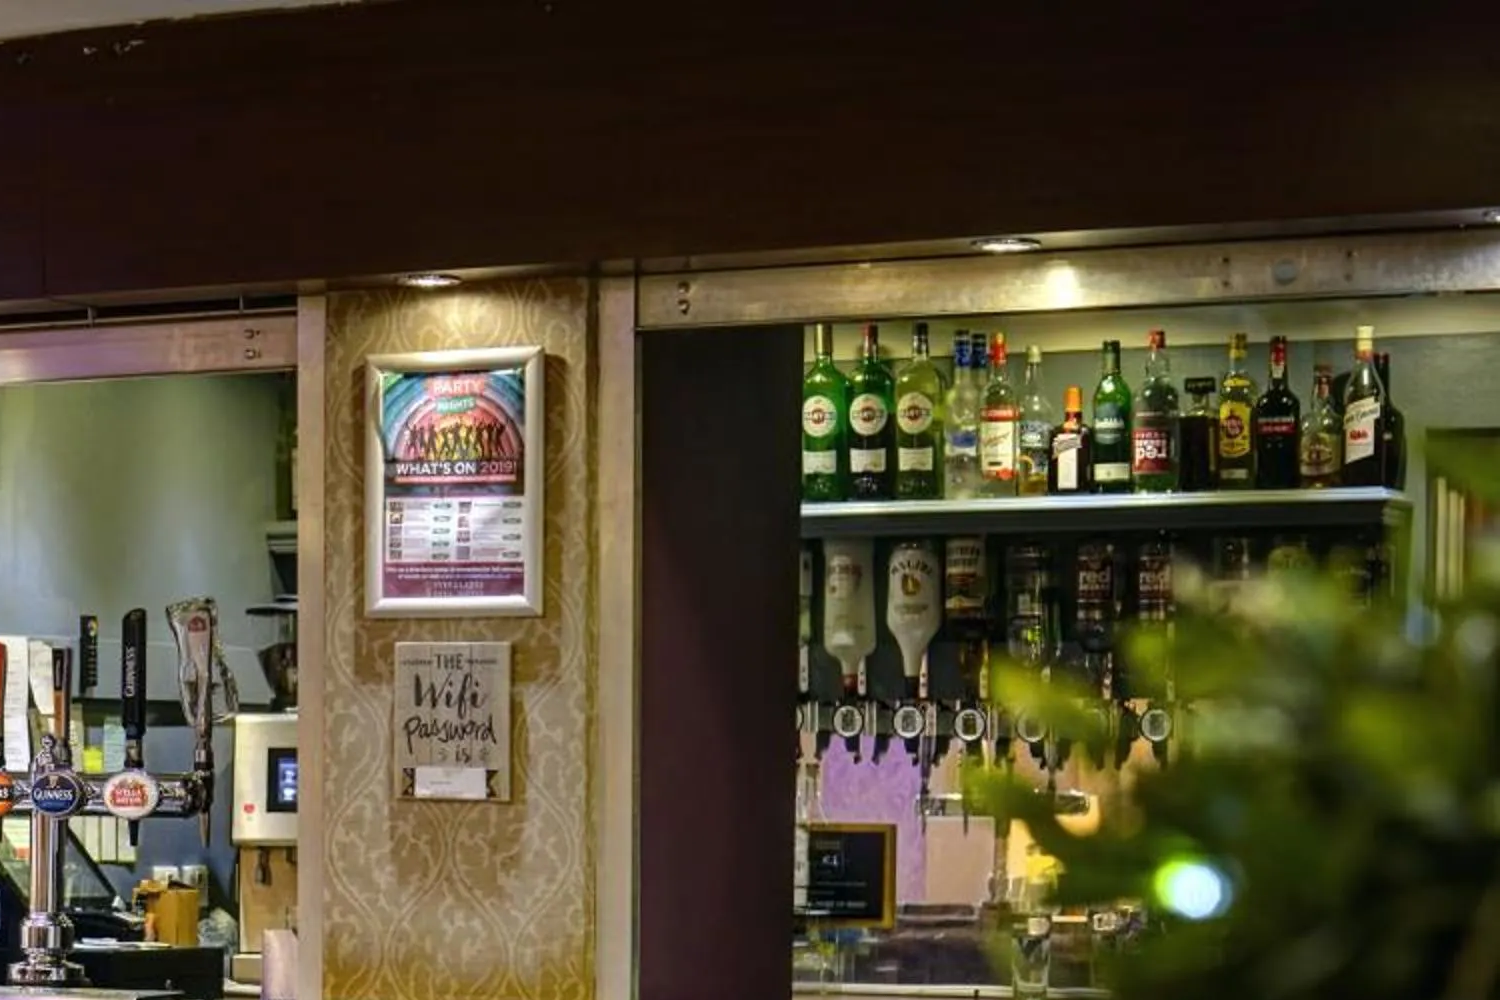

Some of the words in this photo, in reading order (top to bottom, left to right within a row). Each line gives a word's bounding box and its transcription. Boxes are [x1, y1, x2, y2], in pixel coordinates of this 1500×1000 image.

[433, 379, 481, 395] PARTY
[395, 460, 451, 476] WHAT'S
[454, 460, 477, 475] ON
[434, 653, 464, 671] THE
[413, 671, 487, 720] Wifi
[455, 744, 472, 764] is
[33, 787, 73, 801] GUINNESS
